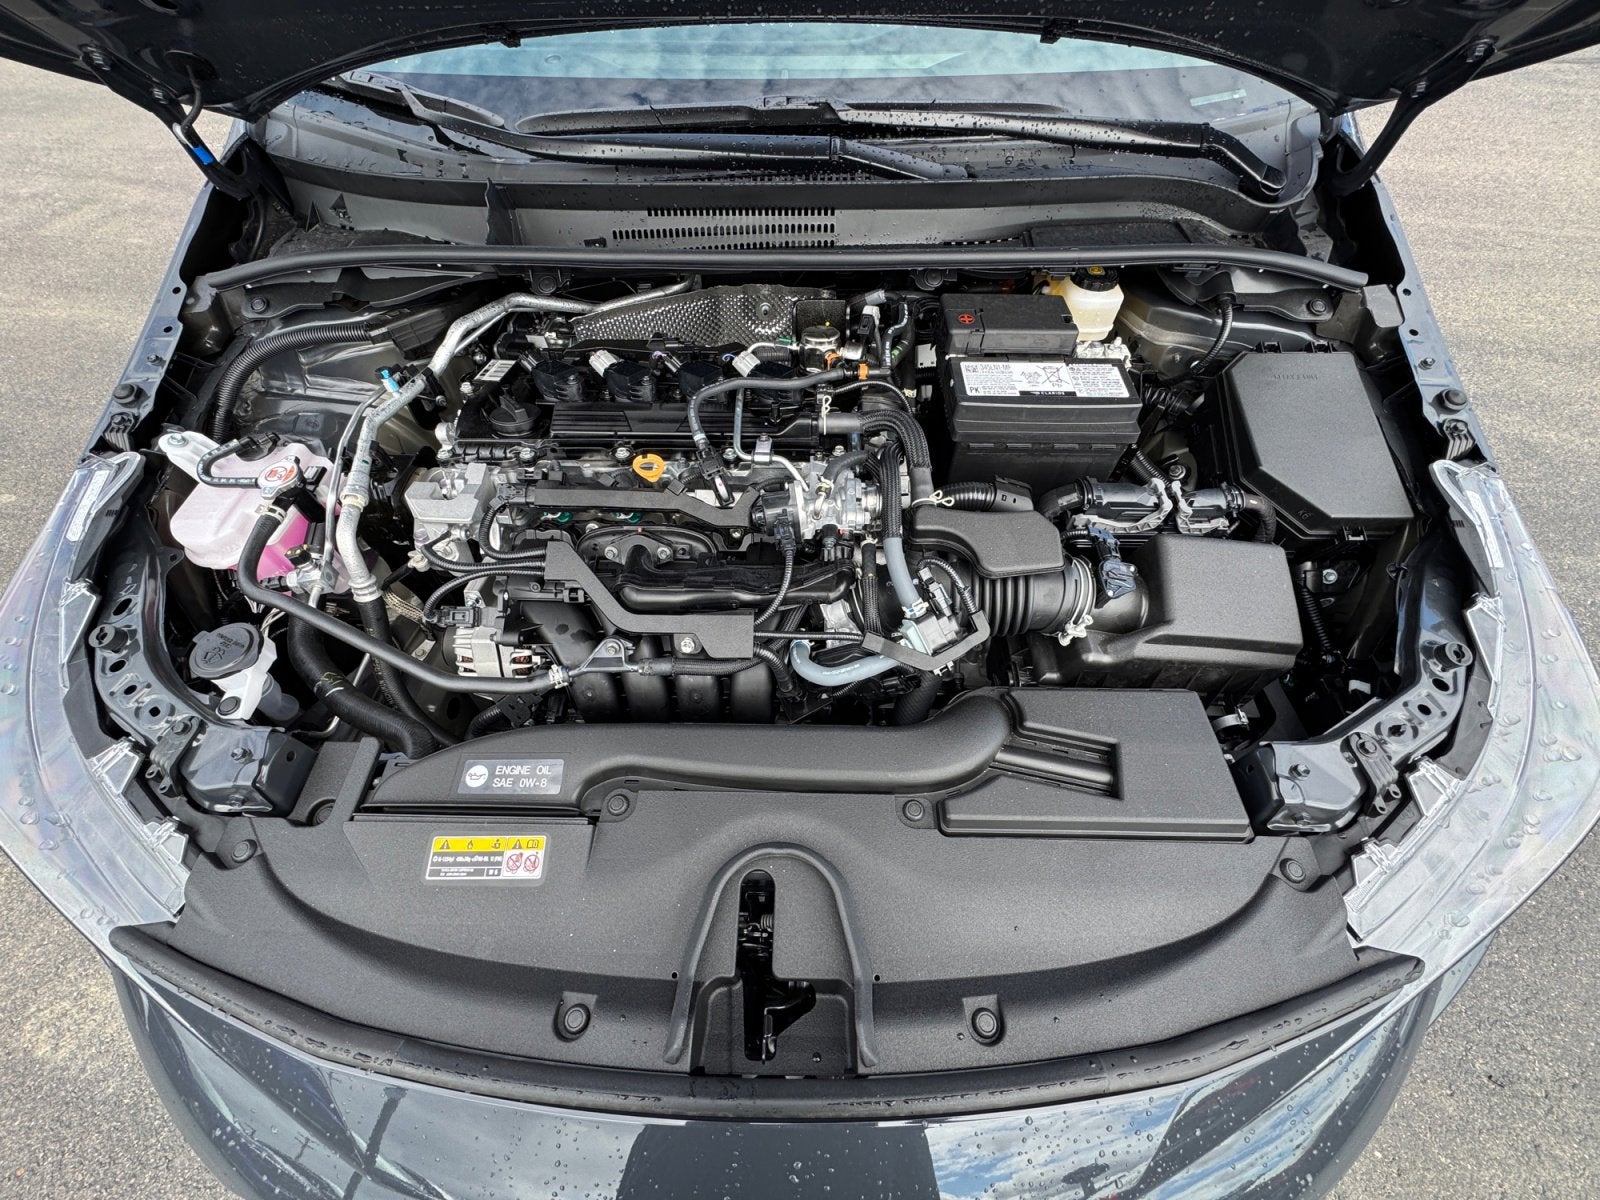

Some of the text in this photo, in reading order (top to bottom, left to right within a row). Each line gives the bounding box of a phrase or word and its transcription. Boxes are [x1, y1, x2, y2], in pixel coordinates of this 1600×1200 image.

[969, 386, 980, 394] PK
[495, 765, 552, 775] ENGINE OIL
[492, 778, 547, 787] SAE 0W-8
